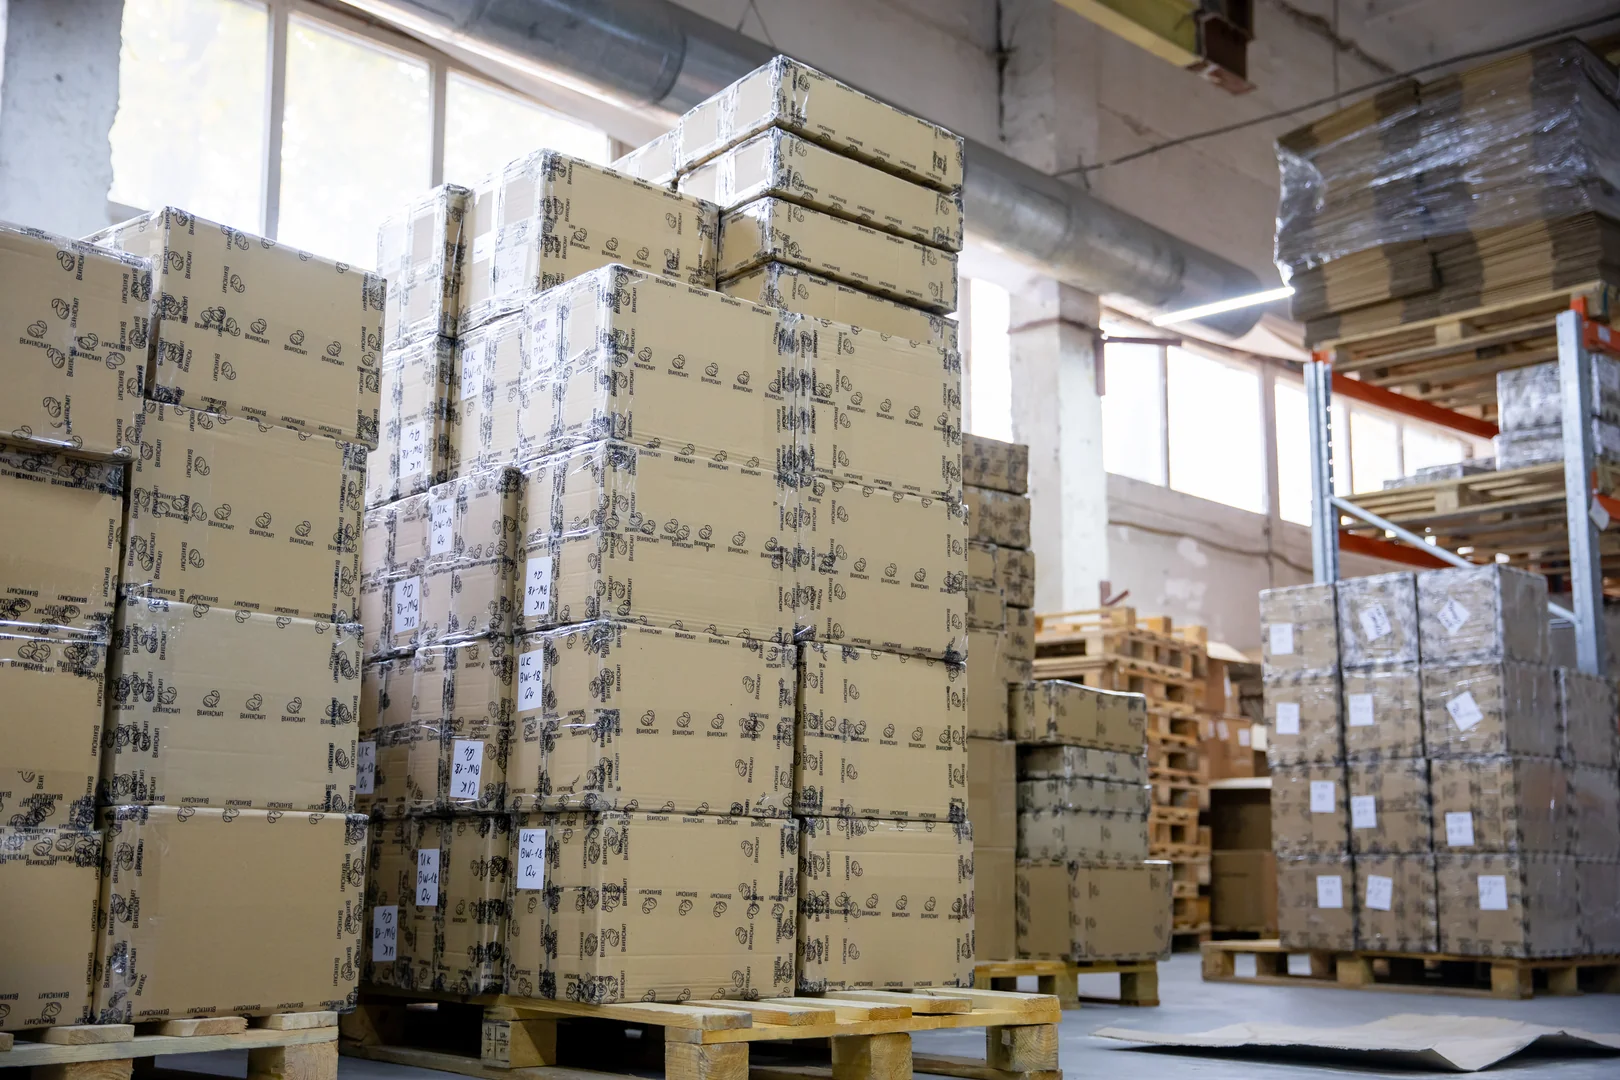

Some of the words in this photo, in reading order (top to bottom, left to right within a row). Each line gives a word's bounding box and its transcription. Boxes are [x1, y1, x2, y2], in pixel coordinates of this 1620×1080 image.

[19, 337, 51, 349] BEAVERCRAFT
[245, 333, 270, 344] BEAVERCRAFT
[284, 344, 307, 355] BEAVERCRAFT
[322, 355, 344, 366] BEAVERCRAFT
[186, 449, 194, 478] BEAVERCRAFT
[437, 504, 448, 515] UK
[208, 520, 234, 530] BEAVERCRAFT
[249, 528, 275, 538] BEAVERCRAFT
[290, 537, 314, 546] BEAVERCRAFT
[534, 600, 545, 610] UK
[404, 616, 415, 628] UK
[521, 657, 531, 666] UK
[240, 712, 266, 720] BEAVERCRAFT
[282, 713, 305, 722] BEAVERCRAFT
[460, 780, 476, 796] UK
[522, 833, 534, 844] UK
[420, 853, 430, 866] UK
[422, 888, 431, 904] Q4
